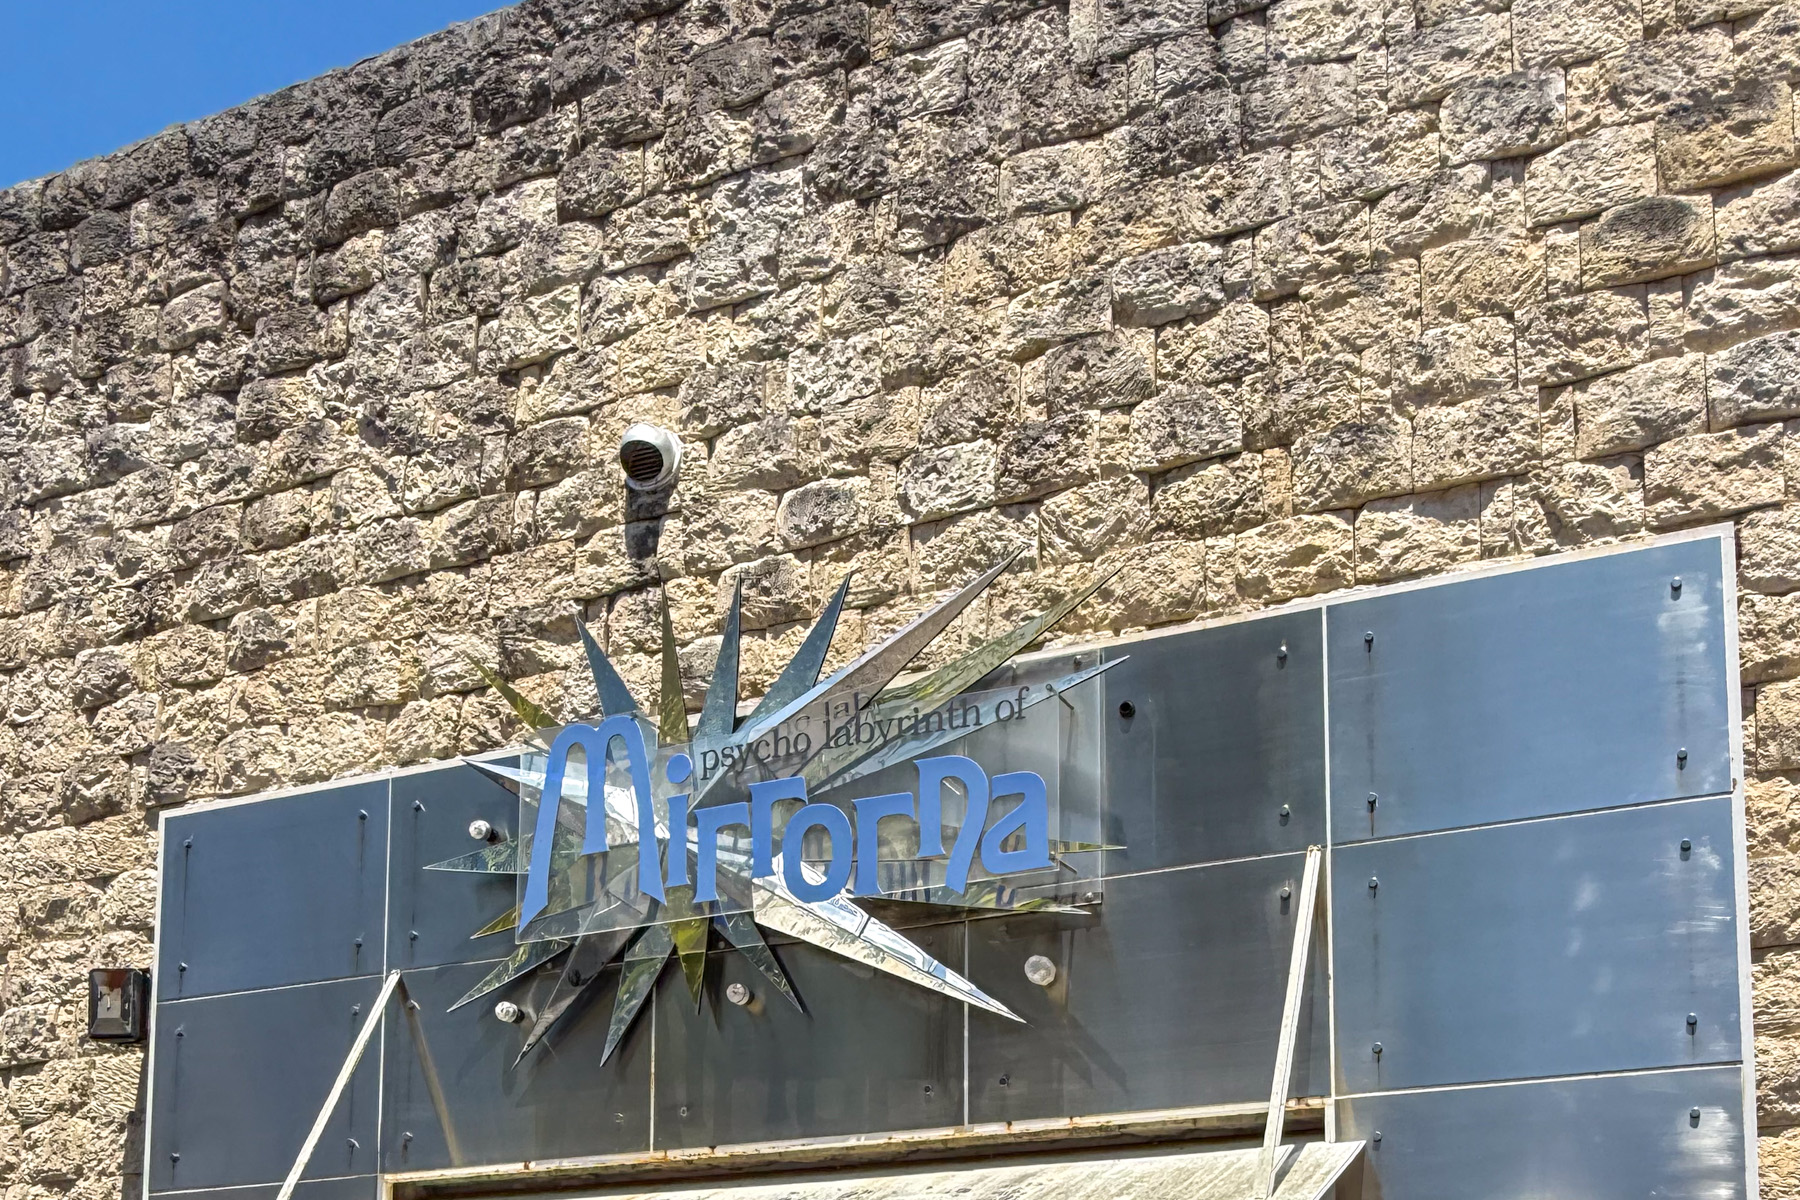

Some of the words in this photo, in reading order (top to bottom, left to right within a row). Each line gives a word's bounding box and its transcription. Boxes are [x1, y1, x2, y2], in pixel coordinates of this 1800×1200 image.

[700, 730, 812, 780] psycho
[824, 701, 983, 749] labyrinth
[995, 686, 1030, 722] of
